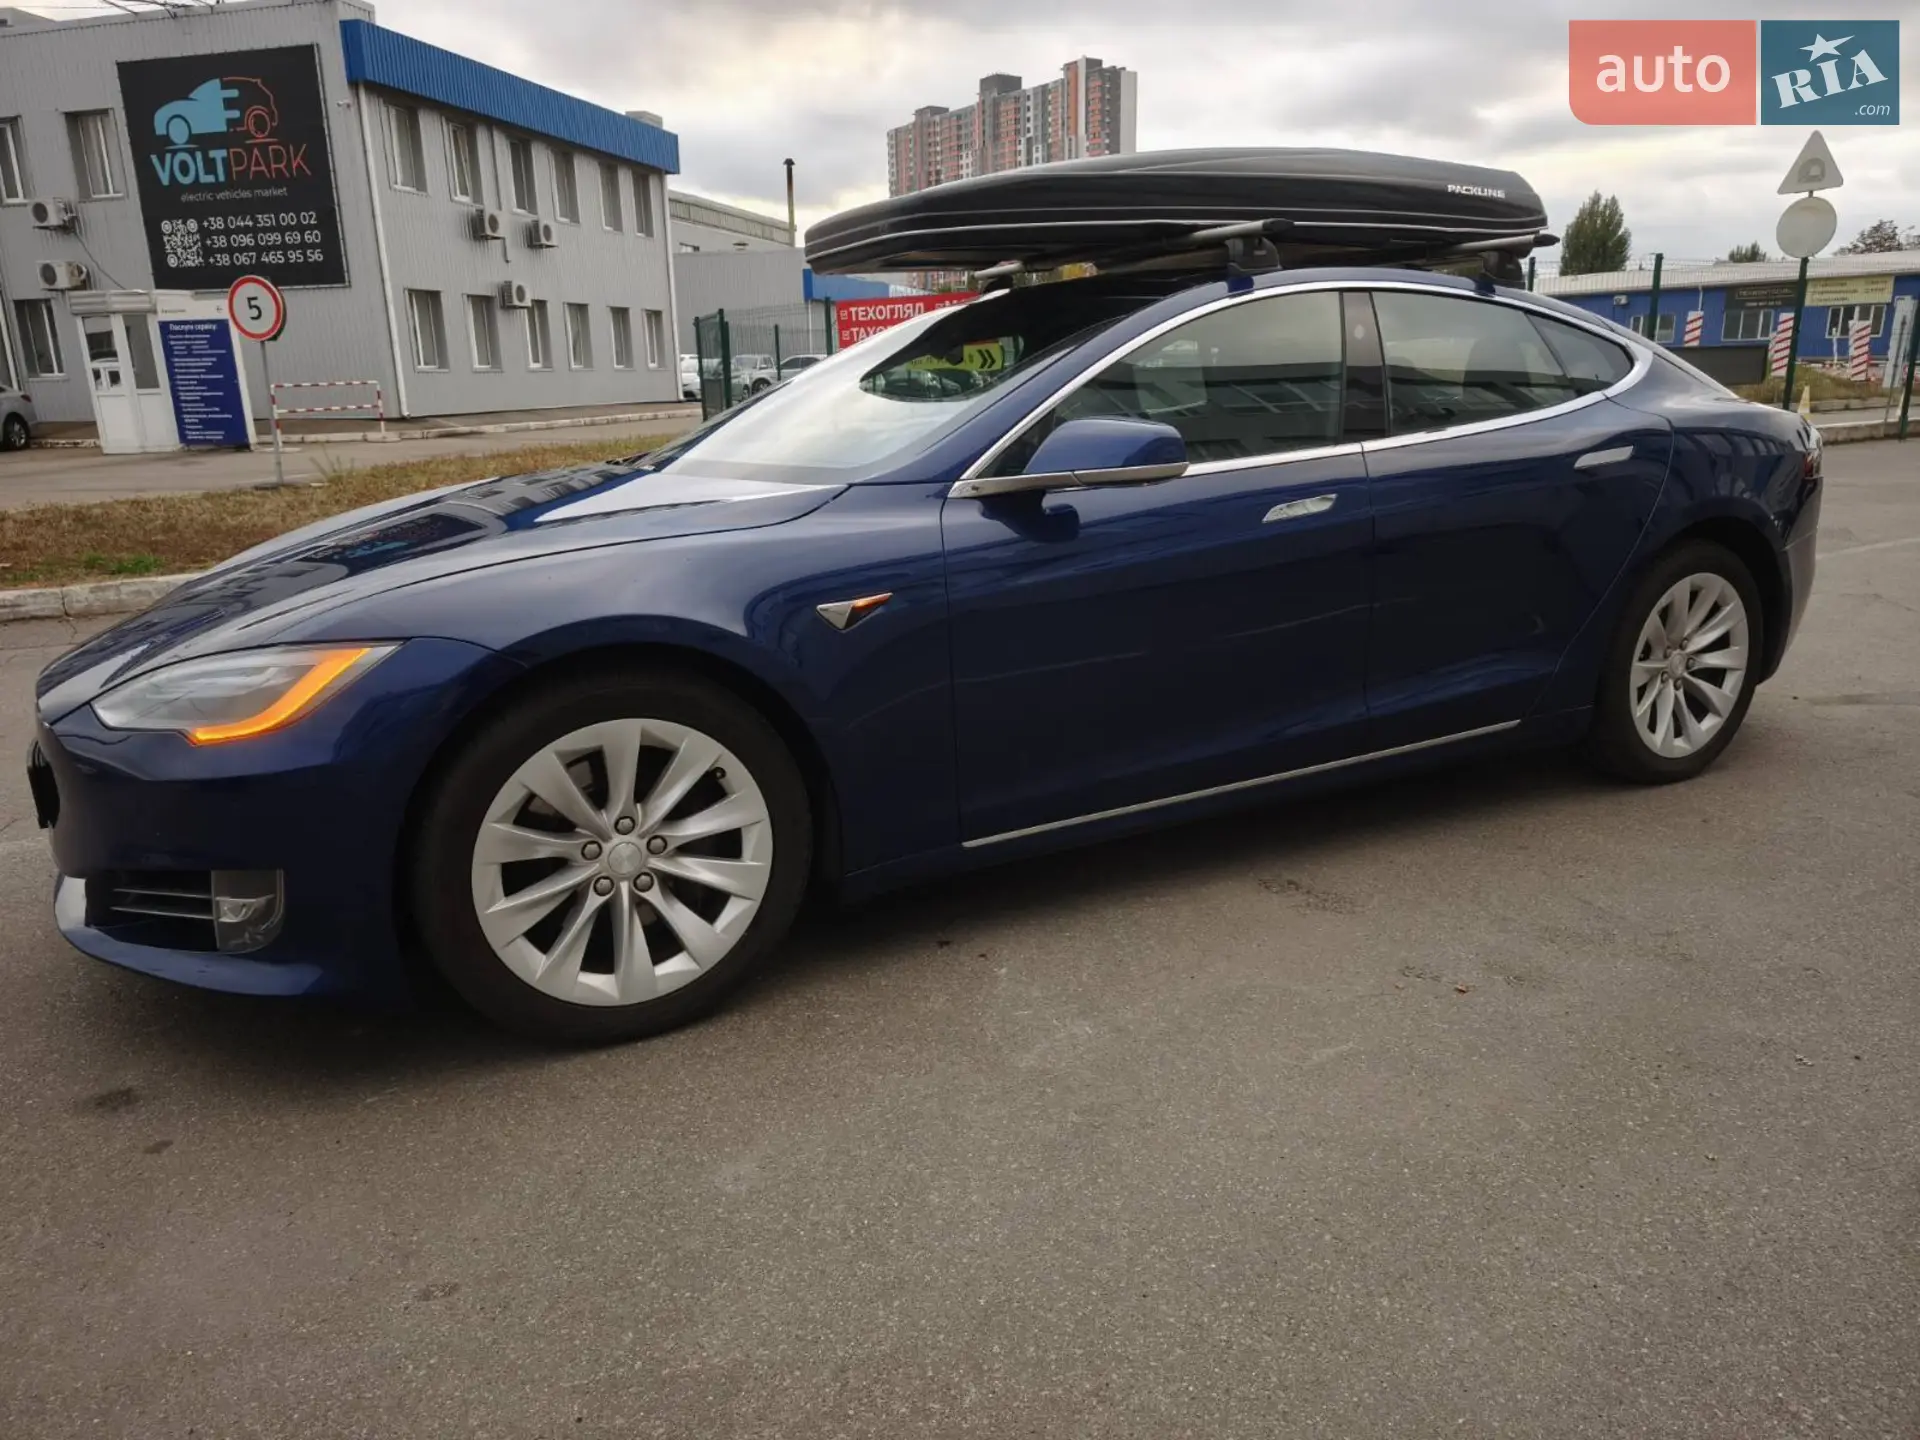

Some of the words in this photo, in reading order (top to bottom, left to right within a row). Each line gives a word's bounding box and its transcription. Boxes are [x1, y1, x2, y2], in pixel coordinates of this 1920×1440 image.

[180, 191, 214, 203] electric
[216, 189, 253, 201] vehicles
[254, 187, 288, 198] market
[1447, 184, 1505, 198] PACKLINE
[202, 216, 224, 230] +38
[227, 215, 253, 229] 044
[256, 213, 276, 227] 351
[278, 212, 297, 226] 00
[300, 211, 318, 225] 02
[205, 235, 227, 248] +38
[230, 234, 255, 247] 096
[257, 232, 282, 246] 099
[284, 231, 301, 245] 69
[304, 229, 321, 243] 60
[208, 253, 231, 266] +38
[233, 252, 257, 265] 067
[260, 251, 285, 264] 465
[287, 250, 304, 263] 95
[306, 249, 324, 262] 56
[246, 296, 262, 321] 5
[849, 302, 924, 322] ТЕХОГЛЯД
